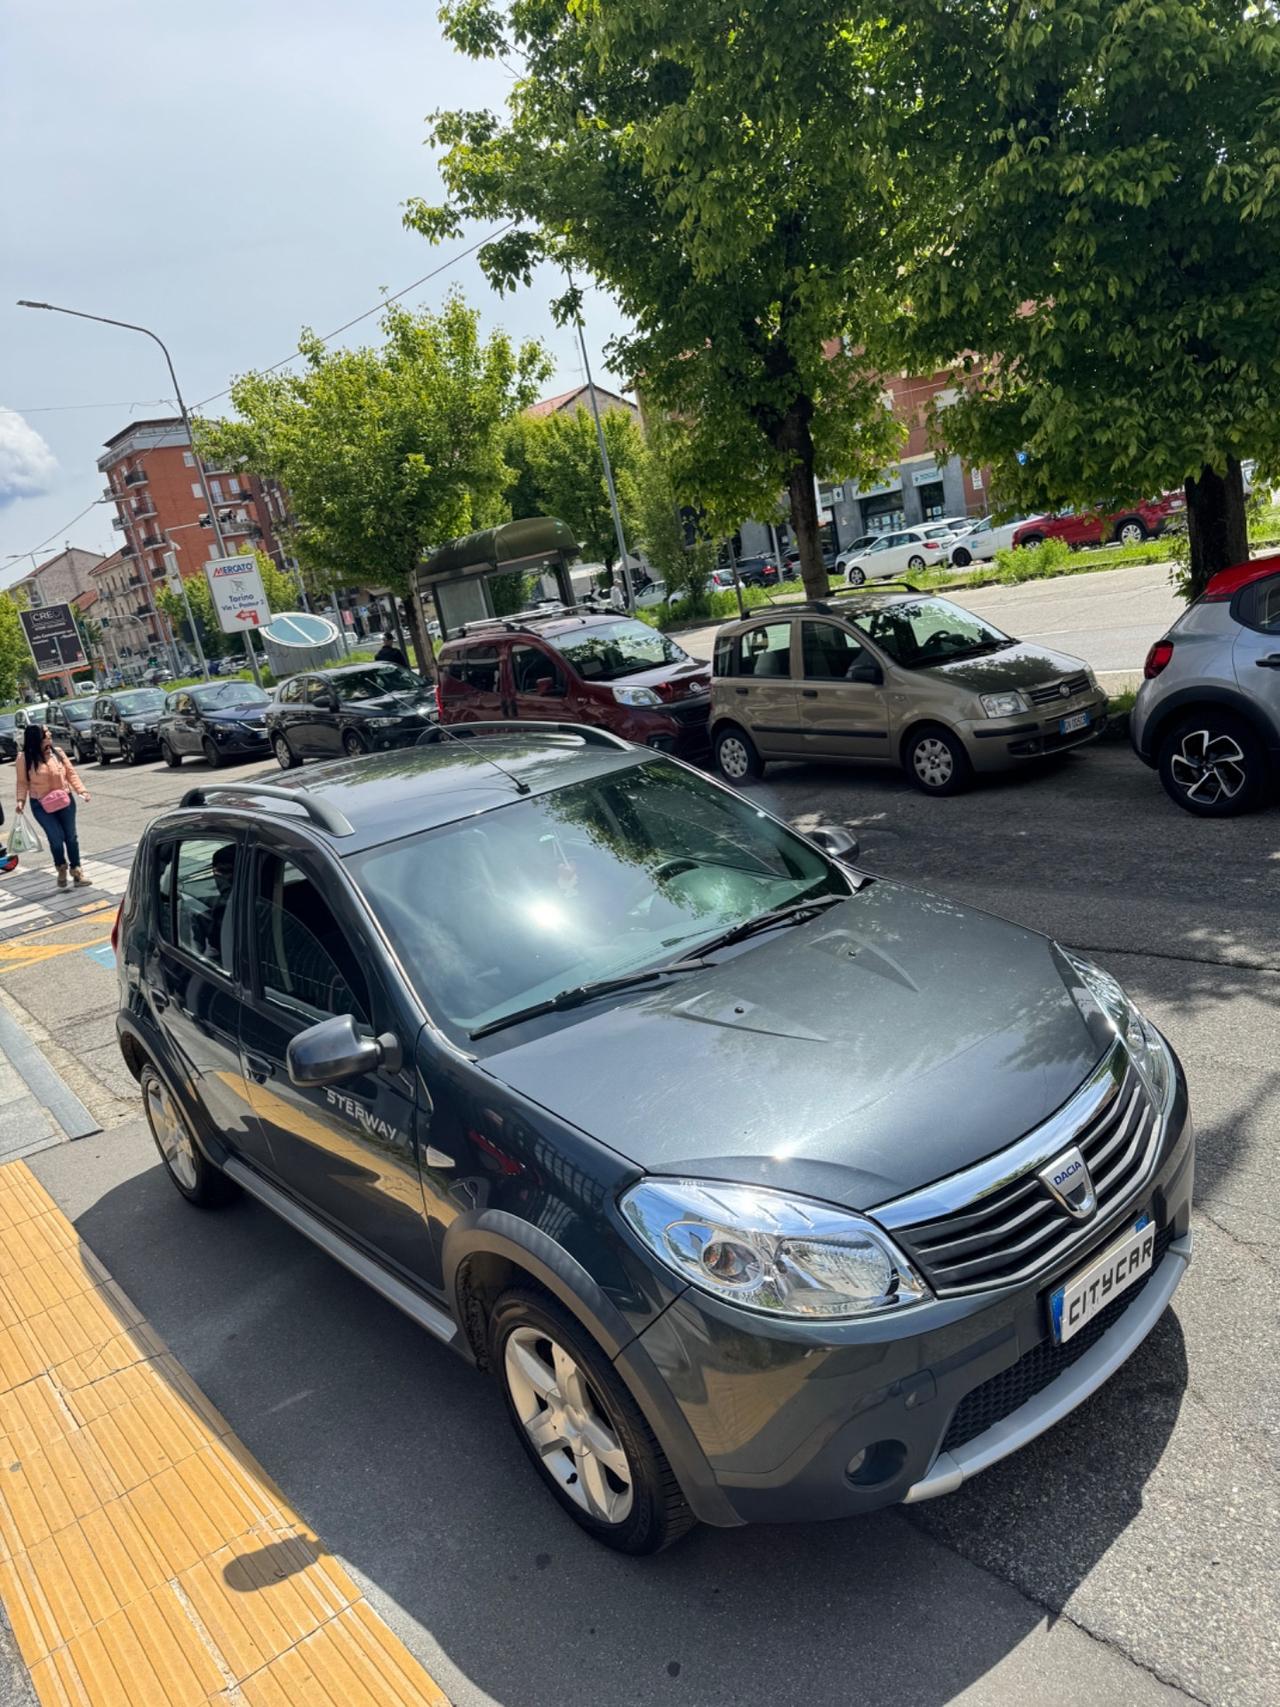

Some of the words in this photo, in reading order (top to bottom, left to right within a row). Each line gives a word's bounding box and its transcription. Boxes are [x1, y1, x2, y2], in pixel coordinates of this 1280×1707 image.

[229, 594, 254, 602] Torino
[1053, 1160, 1082, 1186] DACIA
[1069, 1236, 1153, 1326] CITYCAR
